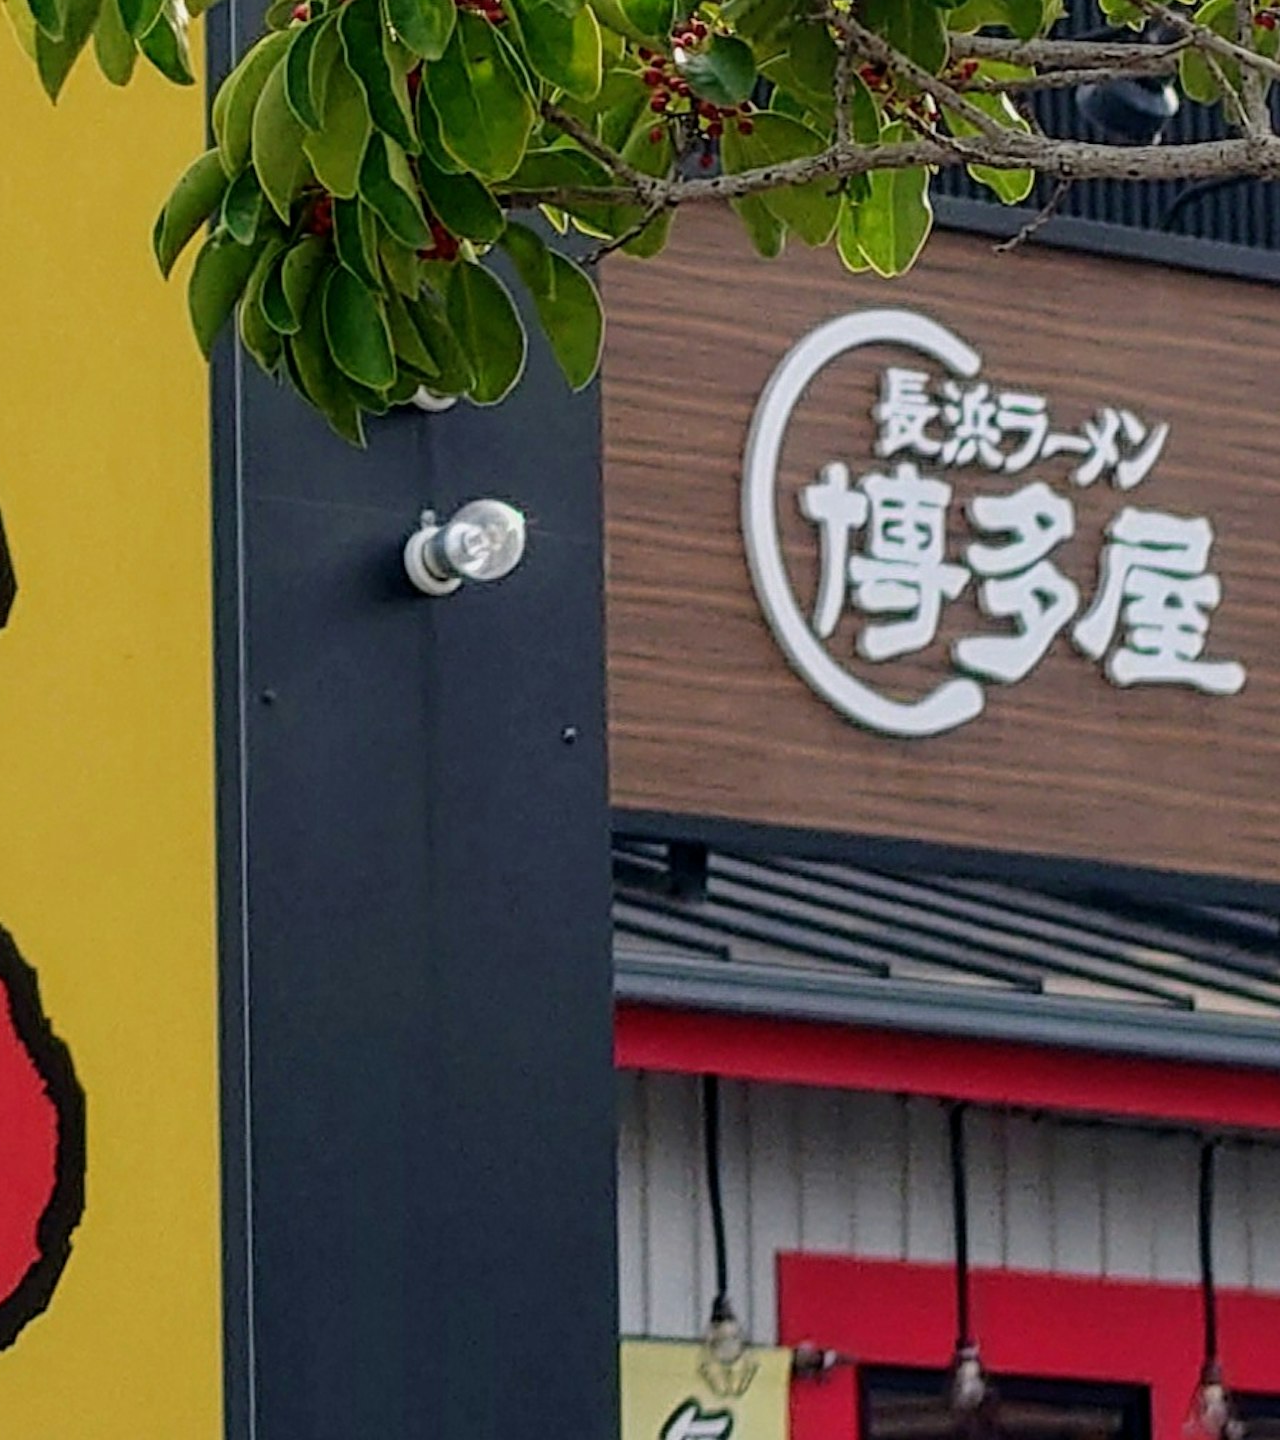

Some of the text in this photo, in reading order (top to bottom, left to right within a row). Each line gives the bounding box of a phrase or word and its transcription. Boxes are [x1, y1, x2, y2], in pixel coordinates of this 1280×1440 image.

[873, 368, 1169, 489] 長浜ラーメン
[801, 462, 1246, 694] 博多屋
